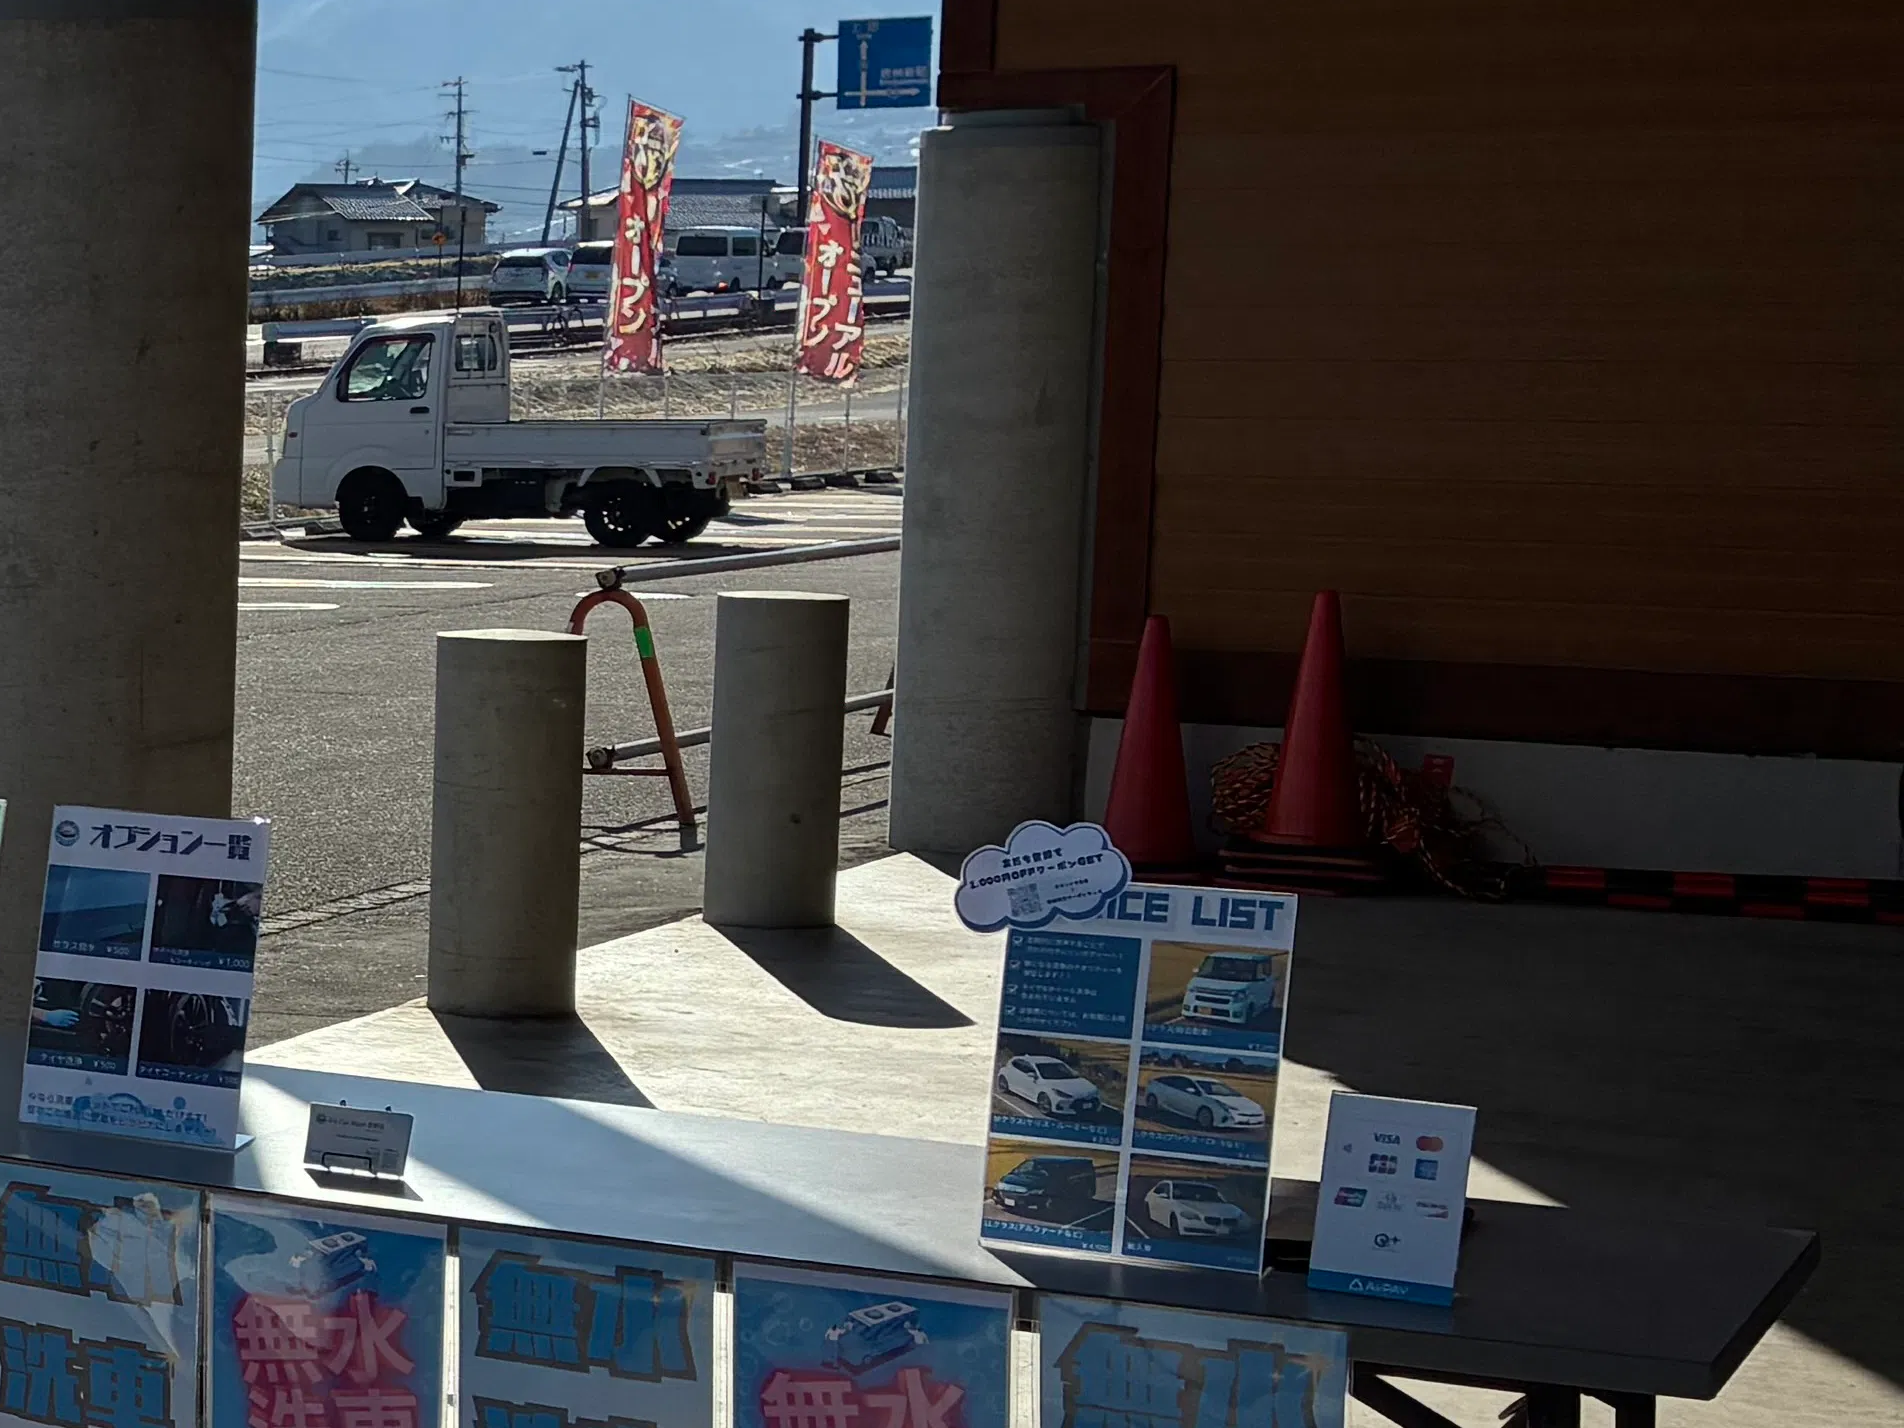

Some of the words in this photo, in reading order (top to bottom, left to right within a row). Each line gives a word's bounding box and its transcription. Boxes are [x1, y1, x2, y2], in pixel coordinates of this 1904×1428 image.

[619, 213, 650, 334] オープン
[804, 239, 844, 347] オープン
[89, 824, 253, 861] オプション一覧
[1191, 897, 1286, 931] LIST
[1373, 1132, 1401, 1146] VISA
[234, 1293, 415, 1384] 無水
